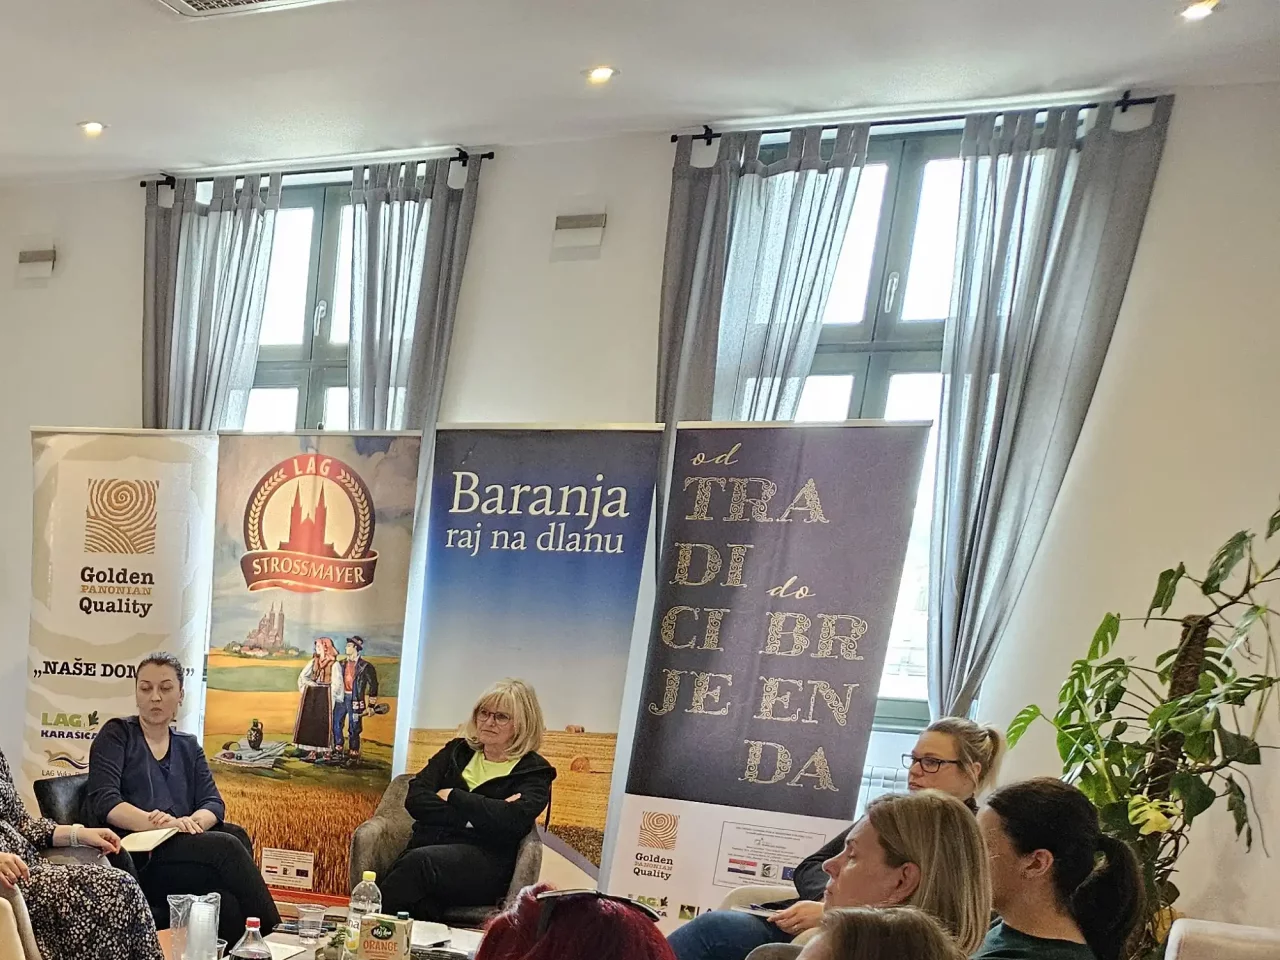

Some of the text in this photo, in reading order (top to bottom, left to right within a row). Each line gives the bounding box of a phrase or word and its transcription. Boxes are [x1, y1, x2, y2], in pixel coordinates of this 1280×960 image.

[293, 457, 332, 477] LAG
[690, 442, 742, 466] od
[448, 471, 630, 531] Baranja
[683, 476, 830, 524] TRA
[445, 522, 624, 557] raj na dlanu
[80, 566, 155, 585] Golden
[252, 556, 366, 584] STROSSMAYER
[669, 542, 755, 588] DI
[80, 584, 153, 596] PANONIAN
[766, 575, 816, 600] do
[79, 596, 153, 618] Quality
[661, 605, 731, 652] CI
[759, 611, 868, 661] BR
[648, 668, 733, 716] JE
[753, 676, 860, 727] EN
[41, 712, 82, 727] LAG
[738, 739, 839, 792] DA
[635, 852, 674, 866] Golden
[633, 867, 672, 881] Quality
[363, 940, 398, 952] ORANGE
